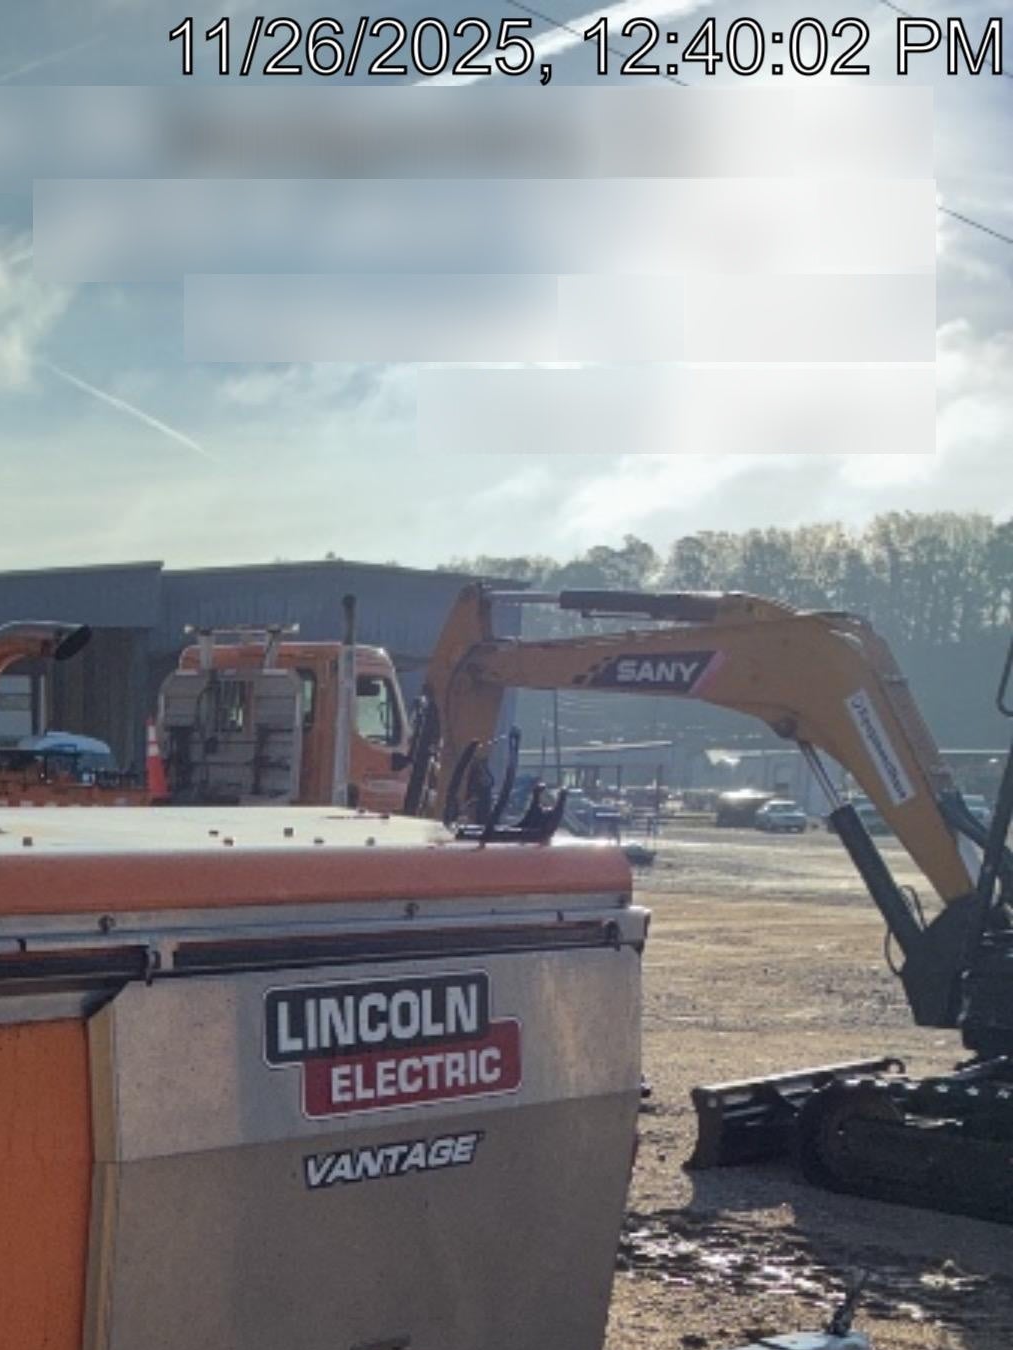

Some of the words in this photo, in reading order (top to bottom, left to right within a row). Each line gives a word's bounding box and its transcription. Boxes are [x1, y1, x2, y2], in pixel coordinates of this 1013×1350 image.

[617, 659, 699, 682] SANY
[277, 984, 478, 1054] LINCOLN
[331, 1046, 502, 1105] ELECTRIC
[305, 1133, 478, 1188] VANTAGE
